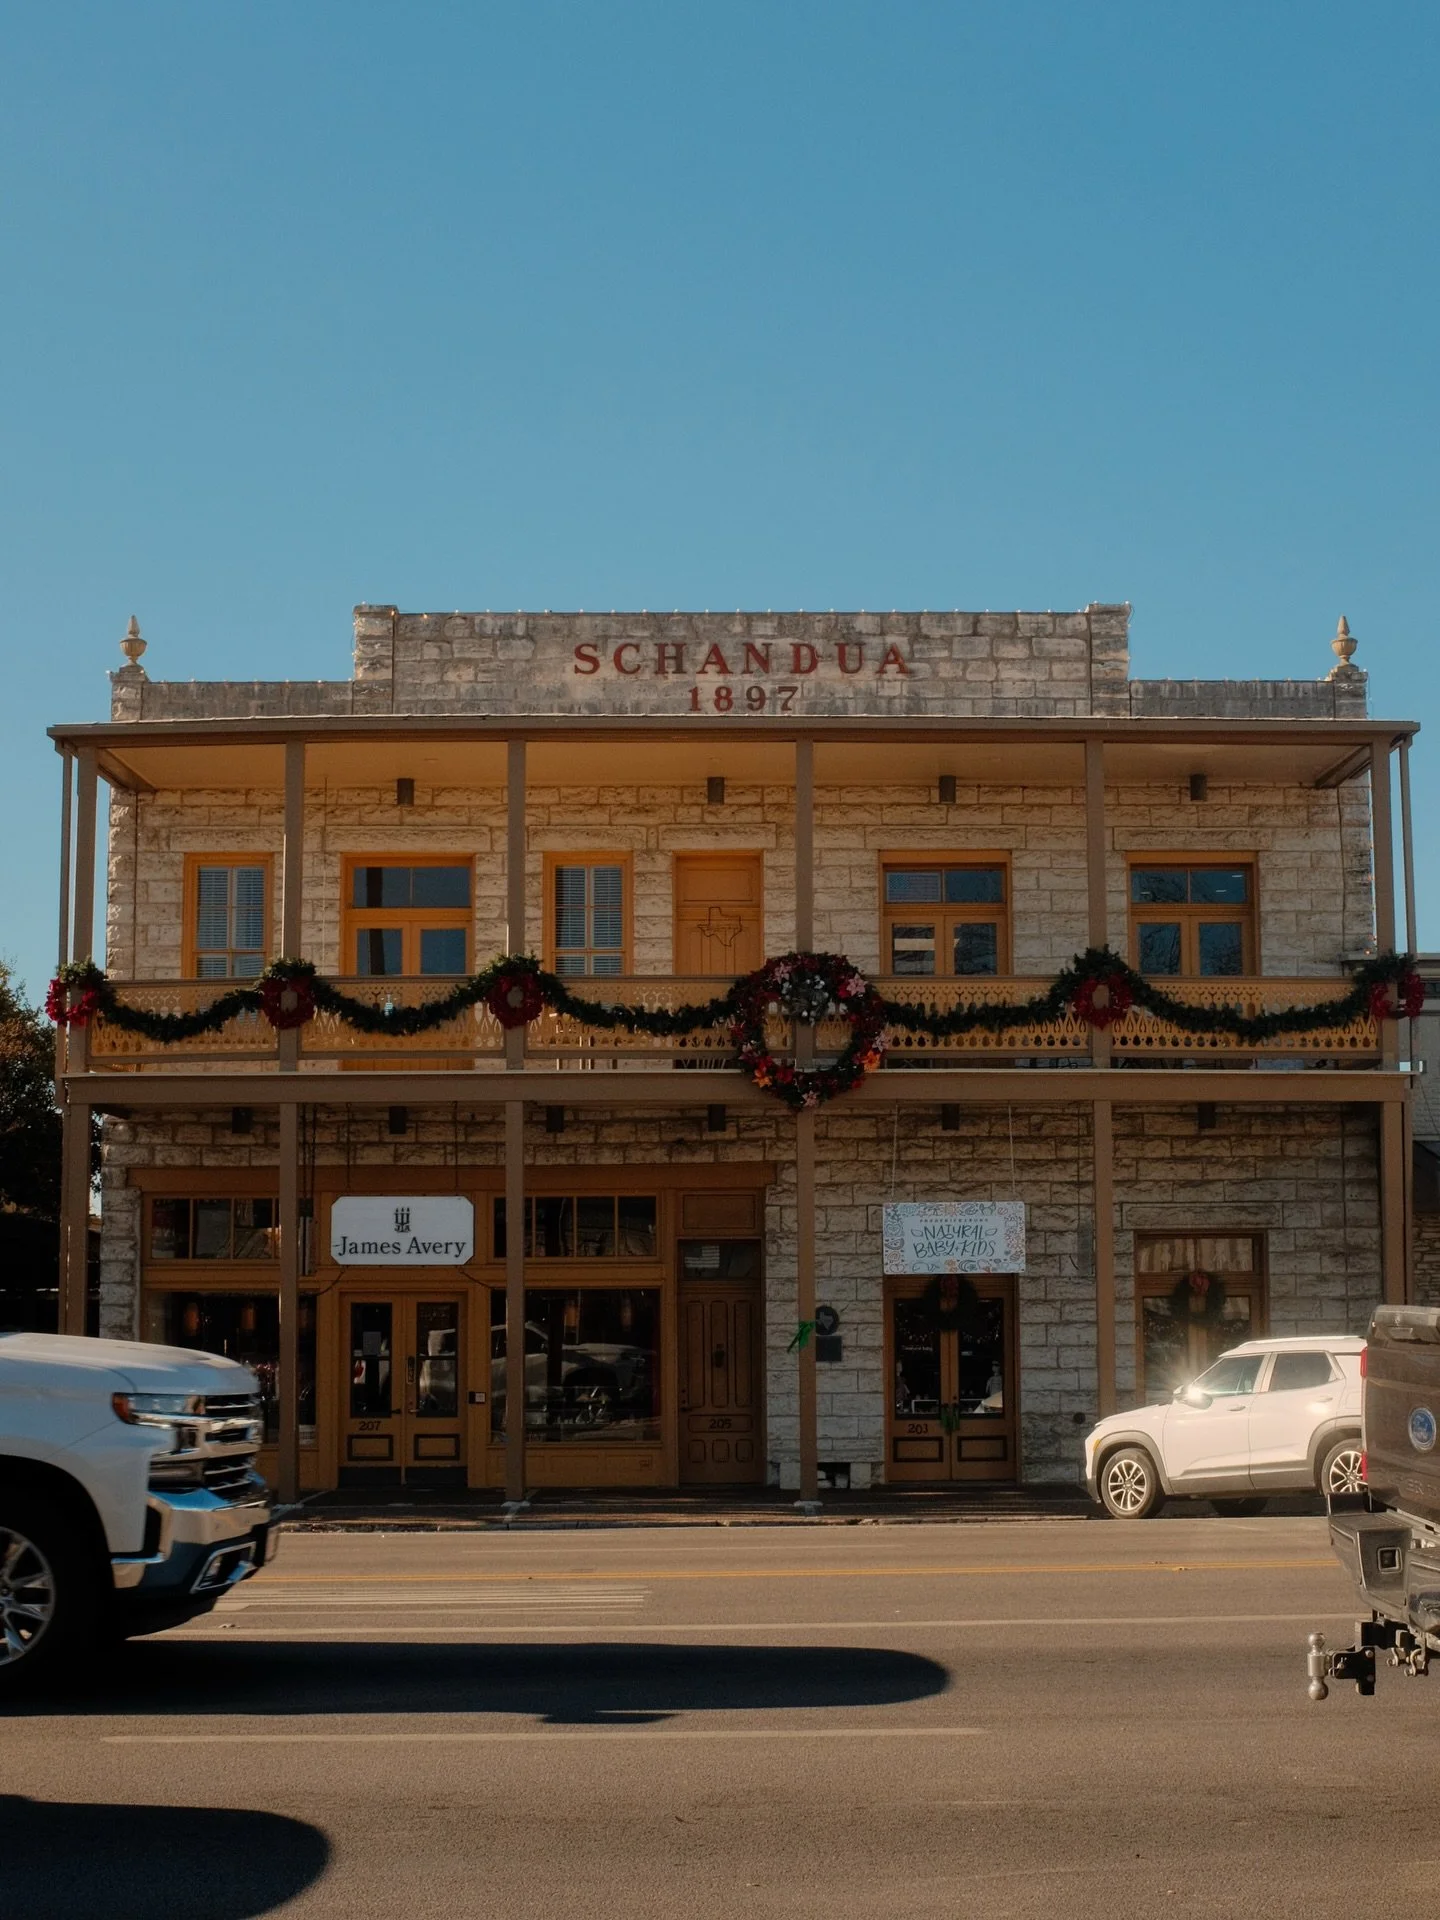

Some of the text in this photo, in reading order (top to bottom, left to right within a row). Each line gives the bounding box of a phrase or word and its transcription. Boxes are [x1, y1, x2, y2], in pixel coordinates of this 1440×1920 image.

[574, 642, 910, 675] SCHANDUA
[688, 686, 799, 712] 1897
[923, 1224, 984, 1240] NATURAL
[338, 1236, 466, 1258] James Avery
[913, 1240, 955, 1258] BABY
[958, 1240, 996, 1257] KIDS
[359, 1421, 382, 1431] 207
[709, 1418, 732, 1429] 205
